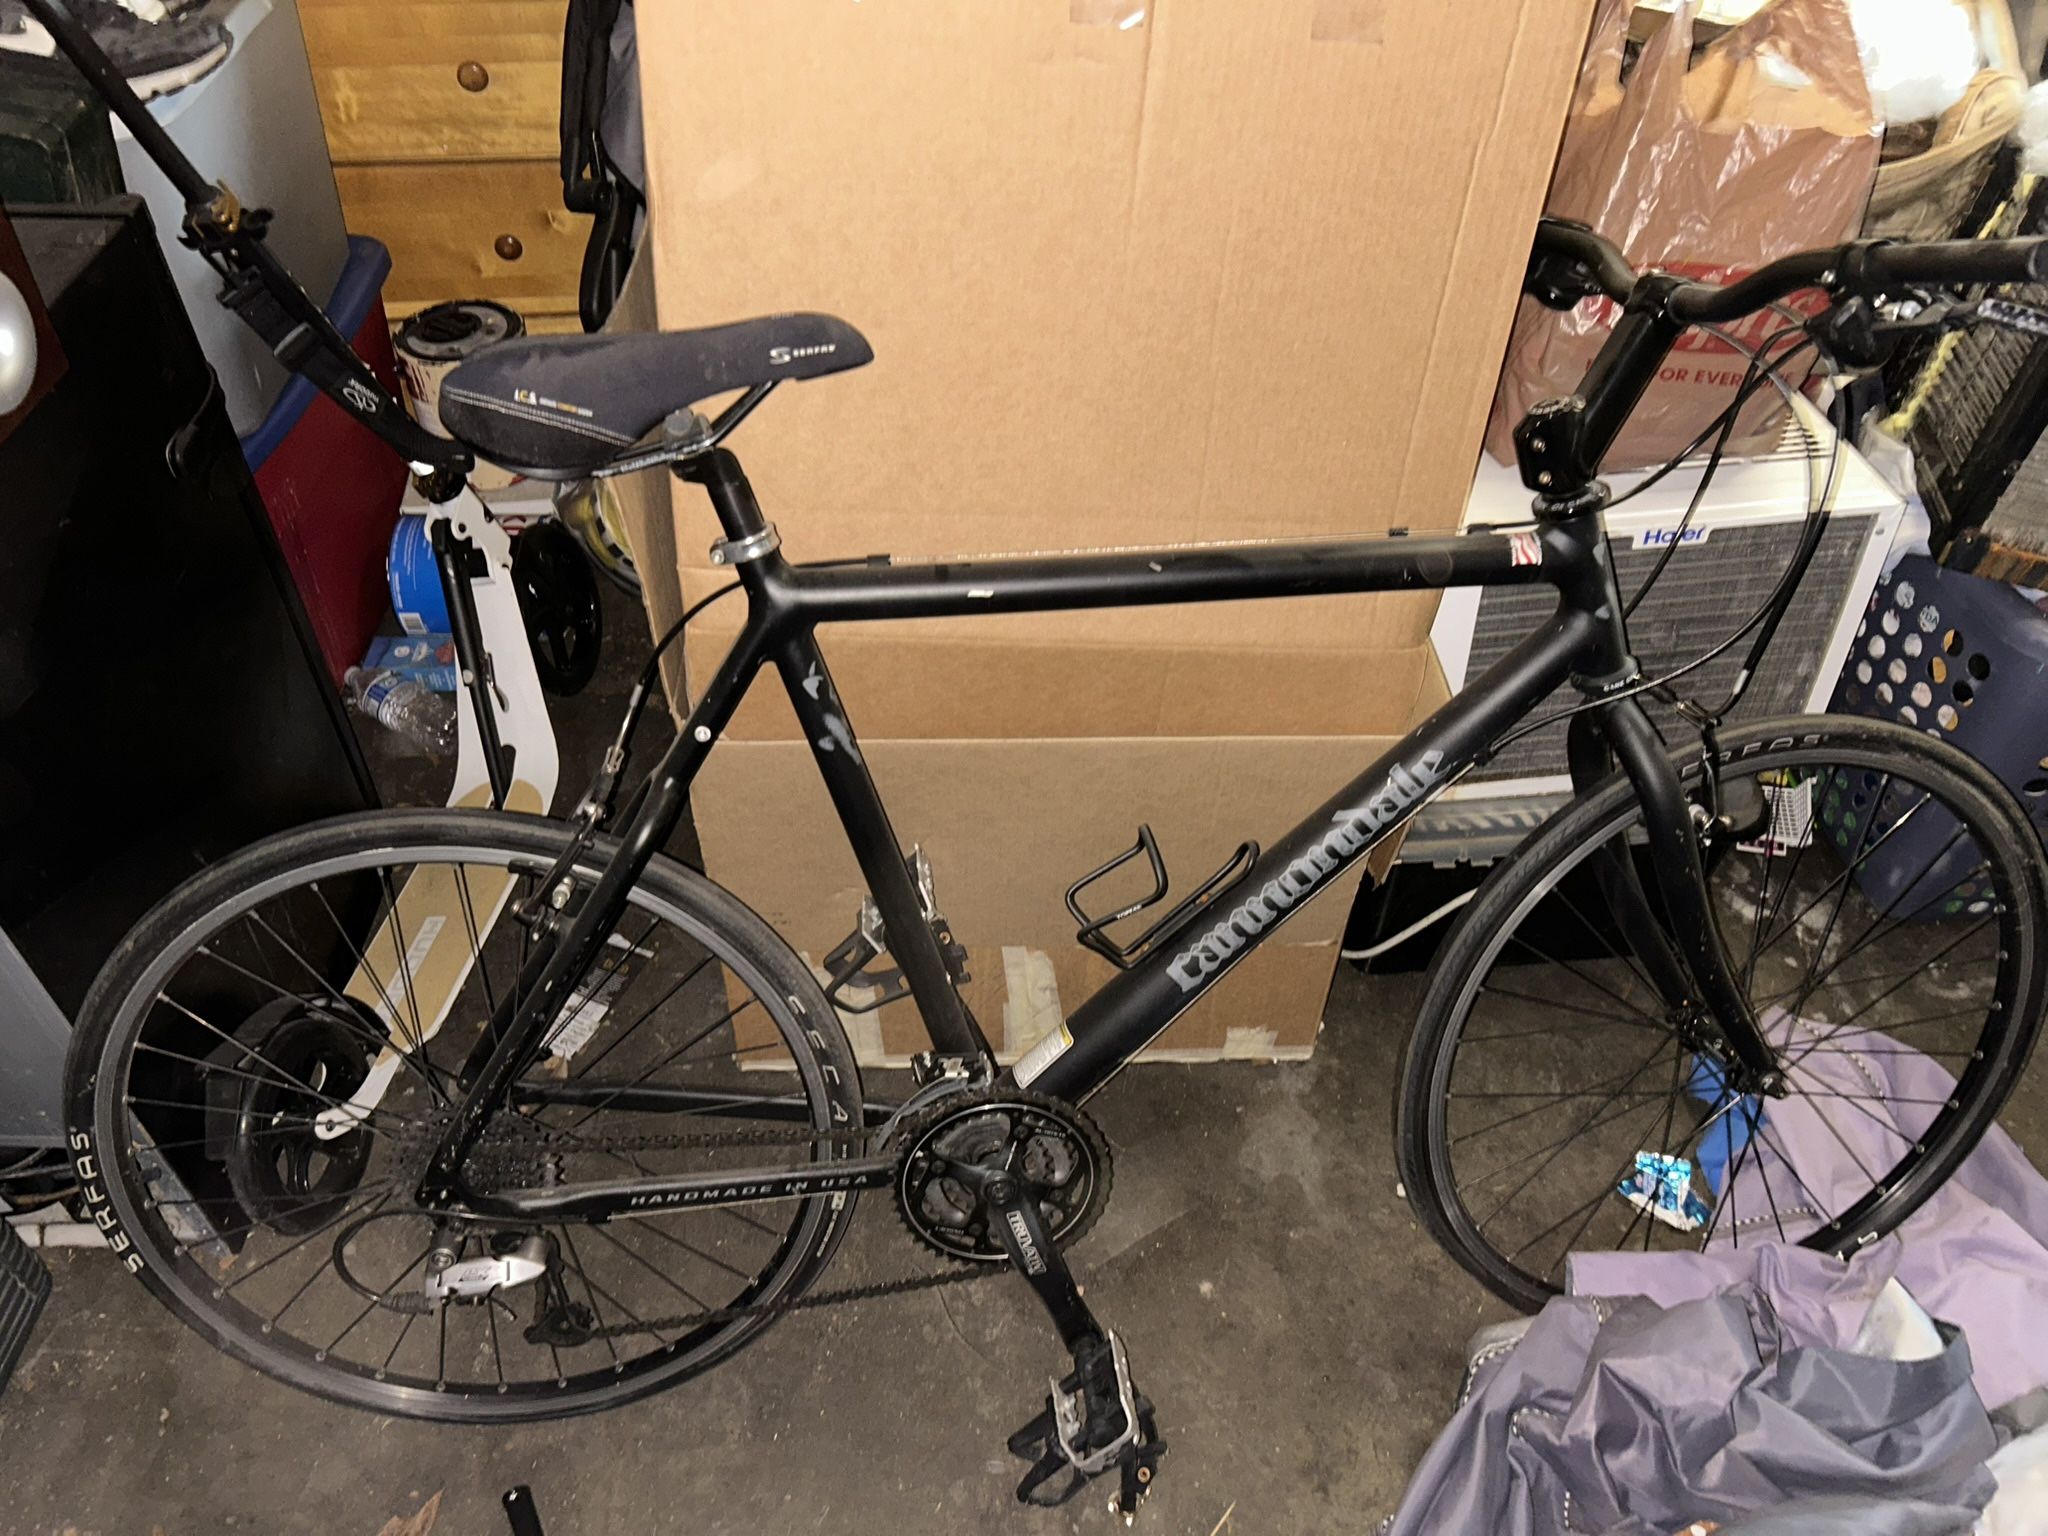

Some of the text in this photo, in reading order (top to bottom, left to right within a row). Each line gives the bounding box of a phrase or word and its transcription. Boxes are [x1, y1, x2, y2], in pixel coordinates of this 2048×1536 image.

[1659, 367, 1688, 382] OR
[1643, 526, 1706, 545] Haer
[70, 1130, 145, 1274] SERFAS
[631, 1175, 868, 1206] HANDMADE IN USA
